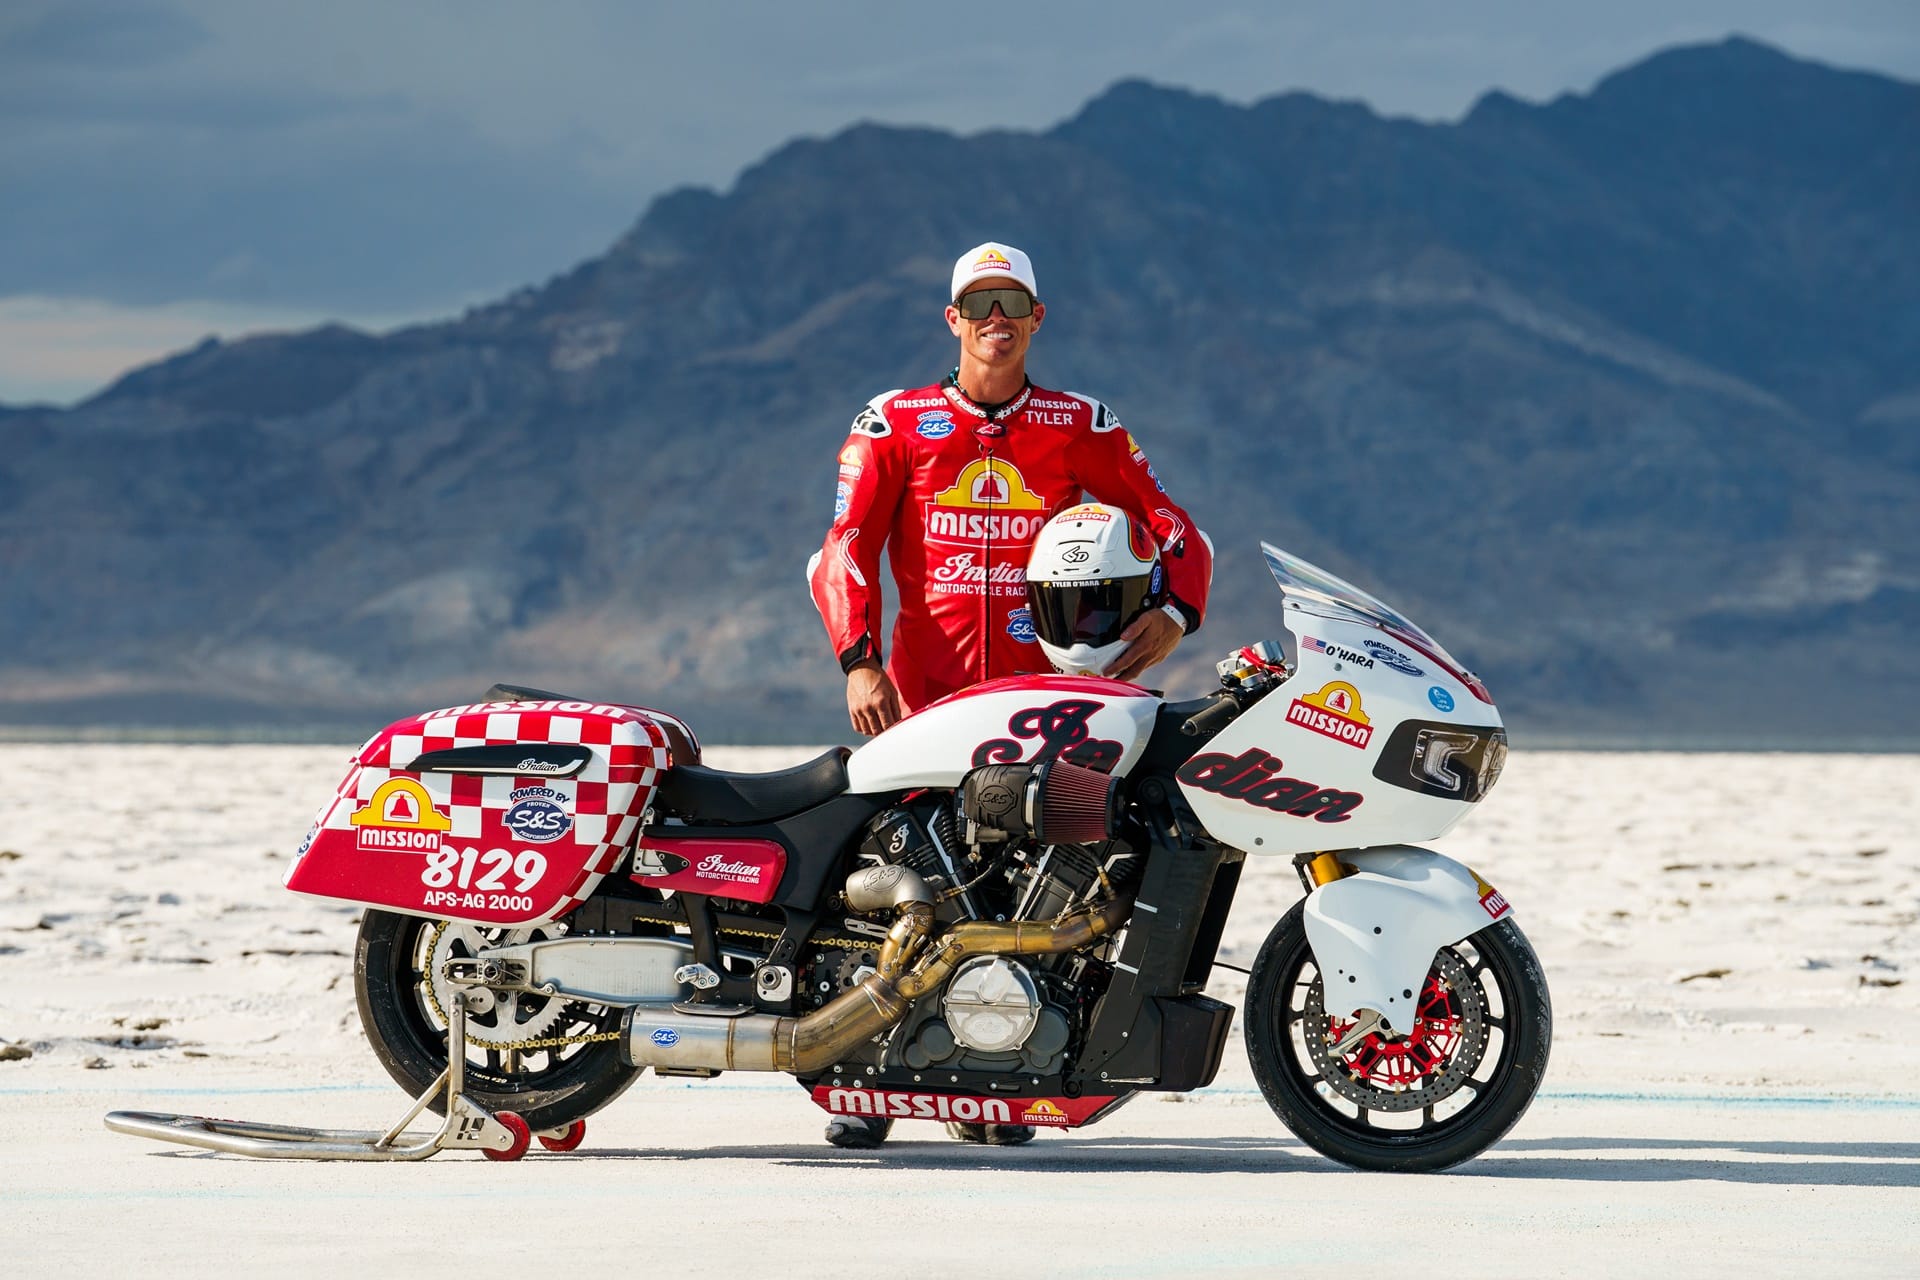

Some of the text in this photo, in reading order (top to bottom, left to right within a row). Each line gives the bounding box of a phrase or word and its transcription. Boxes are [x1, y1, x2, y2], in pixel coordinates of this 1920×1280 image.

[1025, 411, 1073, 425] TYLER
[921, 422, 950, 434] S&S
[933, 583, 1027, 596] MOTORCYCLE RACI
[1363, 640, 1396, 655] POWERED
[1326, 645, 1374, 669] O'HARA
[517, 758, 559, 772] Indian
[1175, 747, 1364, 823] dian
[509, 787, 570, 803] POWERED BY
[982, 792, 1009, 804] S&S
[512, 810, 563, 829] S&S
[519, 830, 559, 840] PERFORMANCE
[421, 845, 548, 893] 8129
[697, 854, 760, 876] Indian
[696, 871, 760, 884] MOTORCYCLE RACING
[869, 868, 896, 883] S&S
[423, 891, 533, 911] APS-AG 2000
[654, 1032, 675, 1041] S&S
